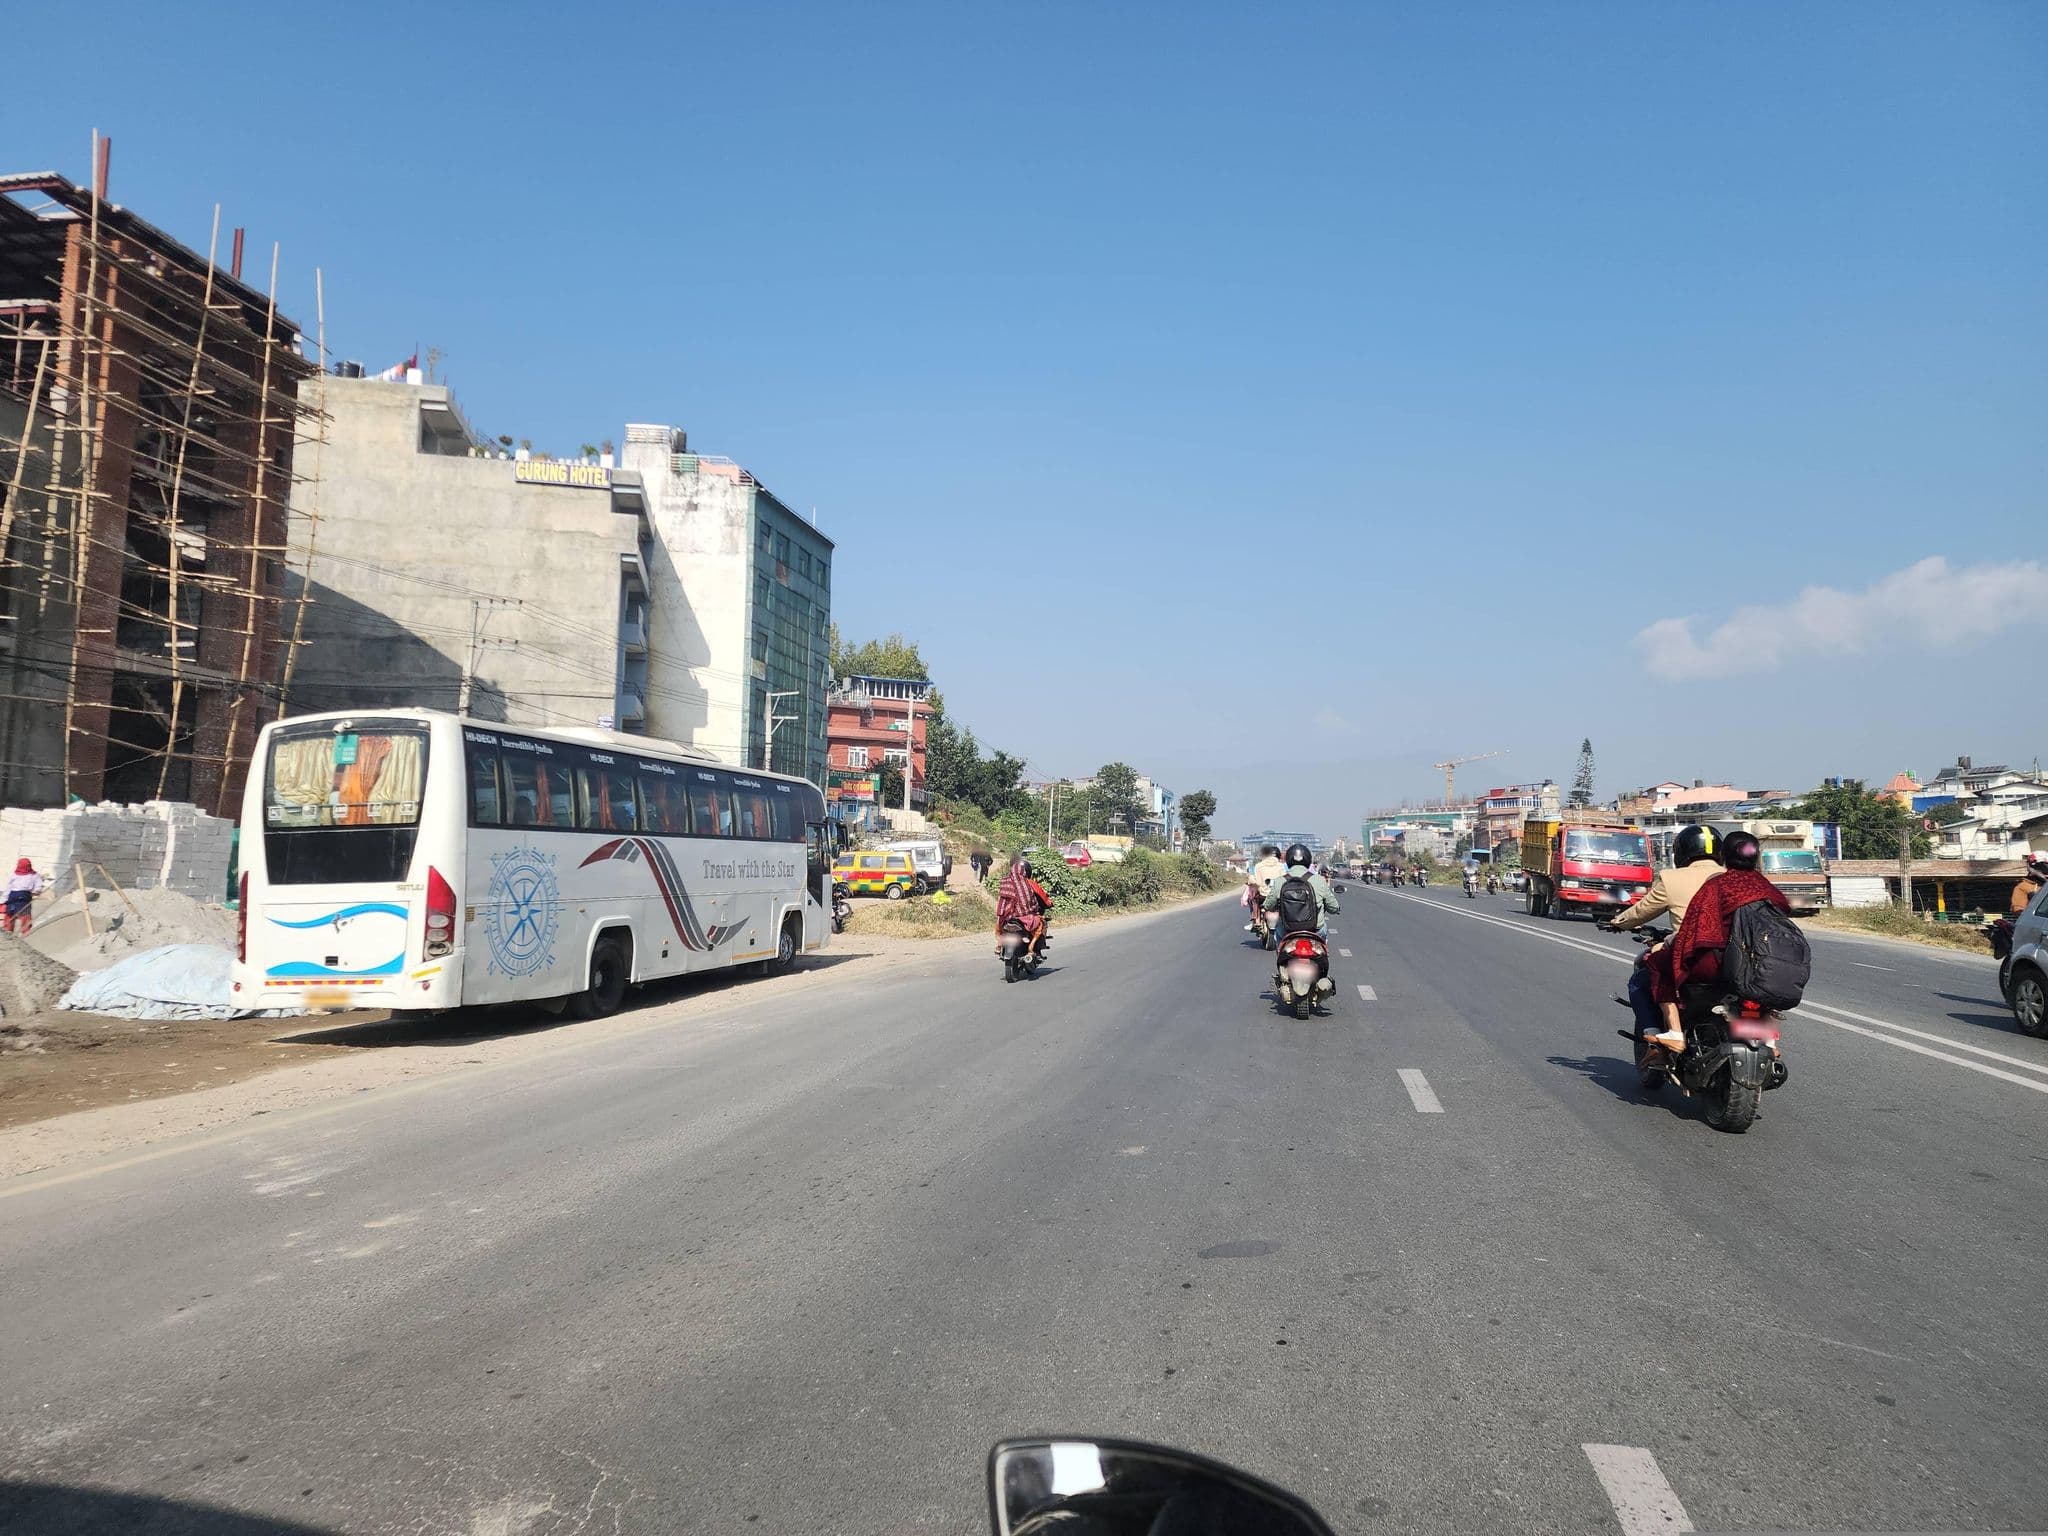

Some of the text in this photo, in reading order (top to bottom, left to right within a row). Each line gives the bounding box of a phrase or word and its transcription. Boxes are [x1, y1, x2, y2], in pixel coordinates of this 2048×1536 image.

[515, 462, 609, 486] GURUNG HOTEL
[465, 731, 498, 745] HI-DECK
[501, 738, 535, 751] Incredible
[589, 753, 616, 765] HI-DECK
[703, 859, 796, 879] Travel with the Star
